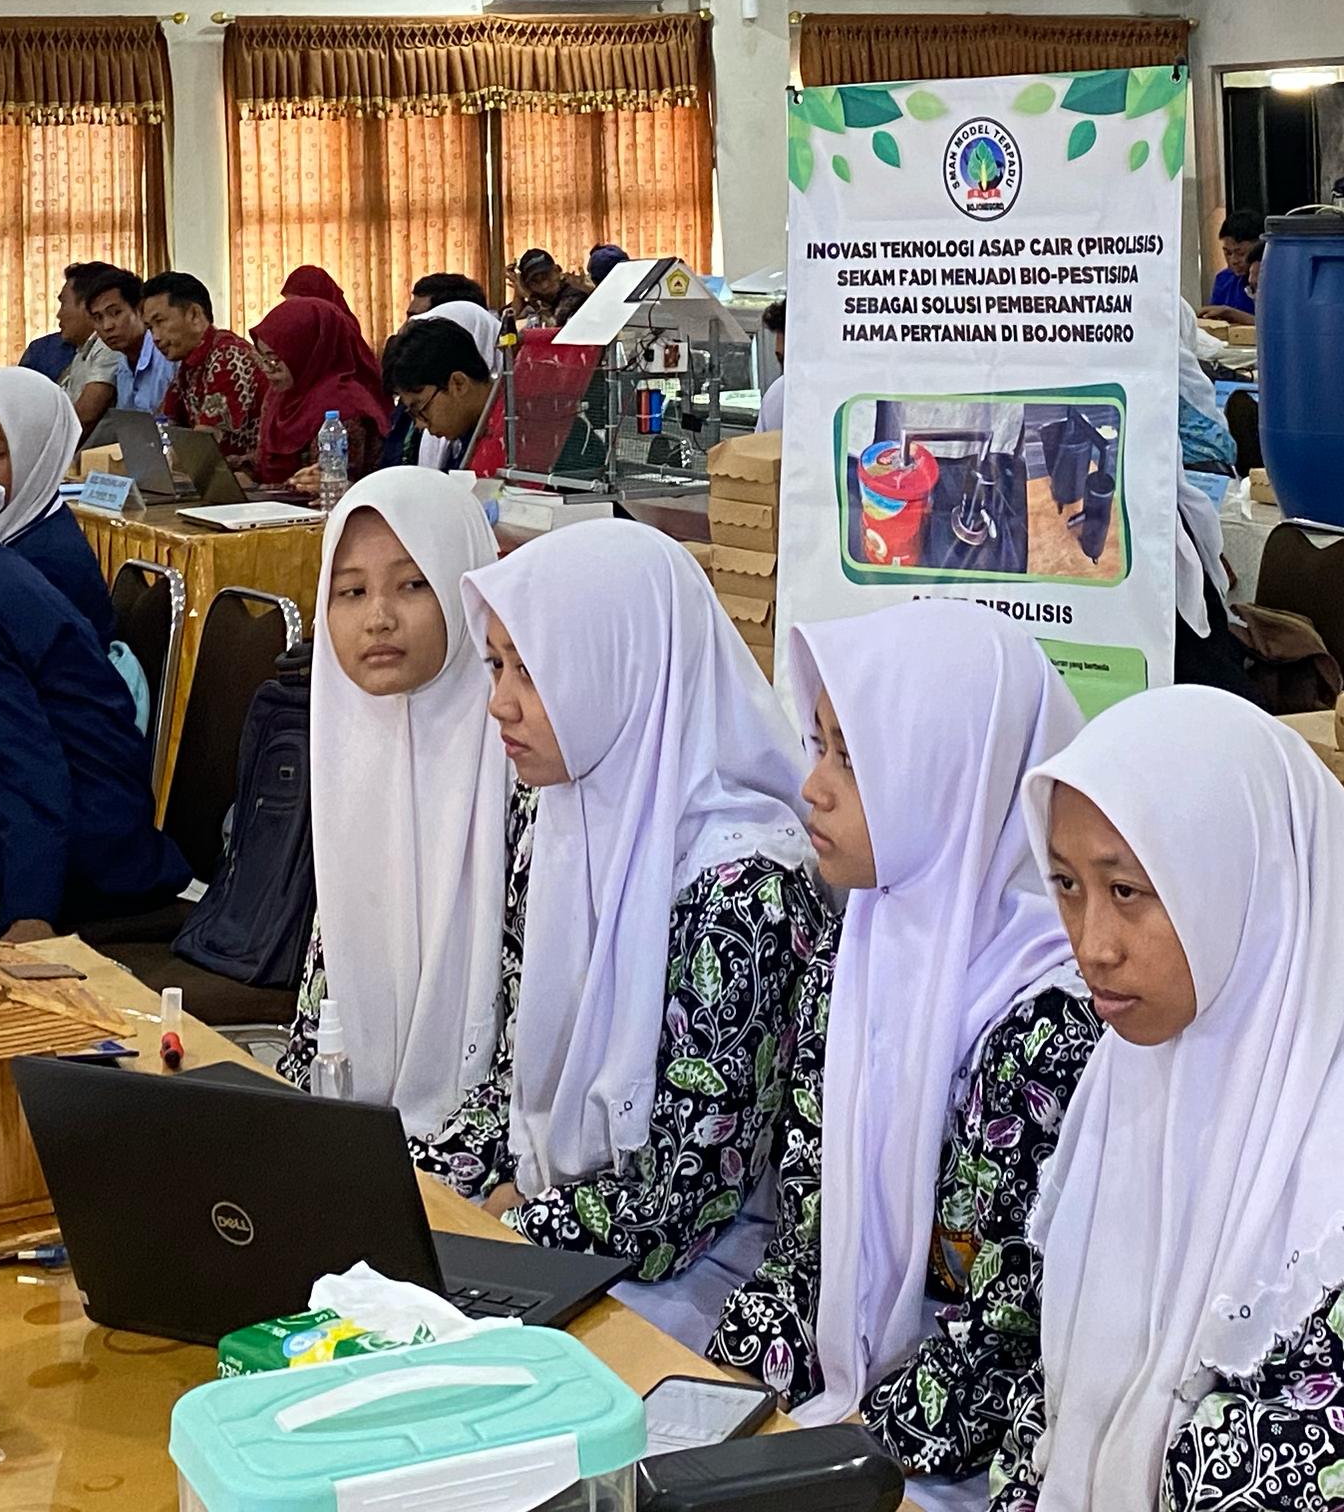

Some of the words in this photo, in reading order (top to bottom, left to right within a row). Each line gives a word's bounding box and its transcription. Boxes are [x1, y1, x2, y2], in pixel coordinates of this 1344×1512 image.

[948, 151, 960, 190] SMAN
[954, 124, 990, 149] MODEL
[993, 128, 1016, 188] TERPADU
[807, 242, 877, 259] INOVASI
[881, 240, 974, 258] TEKNOLOGI
[979, 239, 1025, 257] ASAP
[1030, 238, 1073, 256] CAIR
[1077, 235, 1164, 257] (PIROLISIS)
[837, 269, 895, 286] SEKAM
[899, 269, 937, 286] PADI
[941, 267, 1016, 286] MENJADI
[1020, 265, 1139, 285] BIO-PESTISIDA
[844, 297, 918, 314] SEBAGAI
[921, 296, 981, 314] SOLUSI
[986, 294, 1132, 314] PEMBERANTASAN
[842, 324, 898, 342] HAMA
[901, 324, 997, 342] PERTANIAN
[1001, 325, 1018, 342] DI
[1022, 324, 1134, 343] BOJONEGORO
[217, 1216, 250, 1232] DELL
